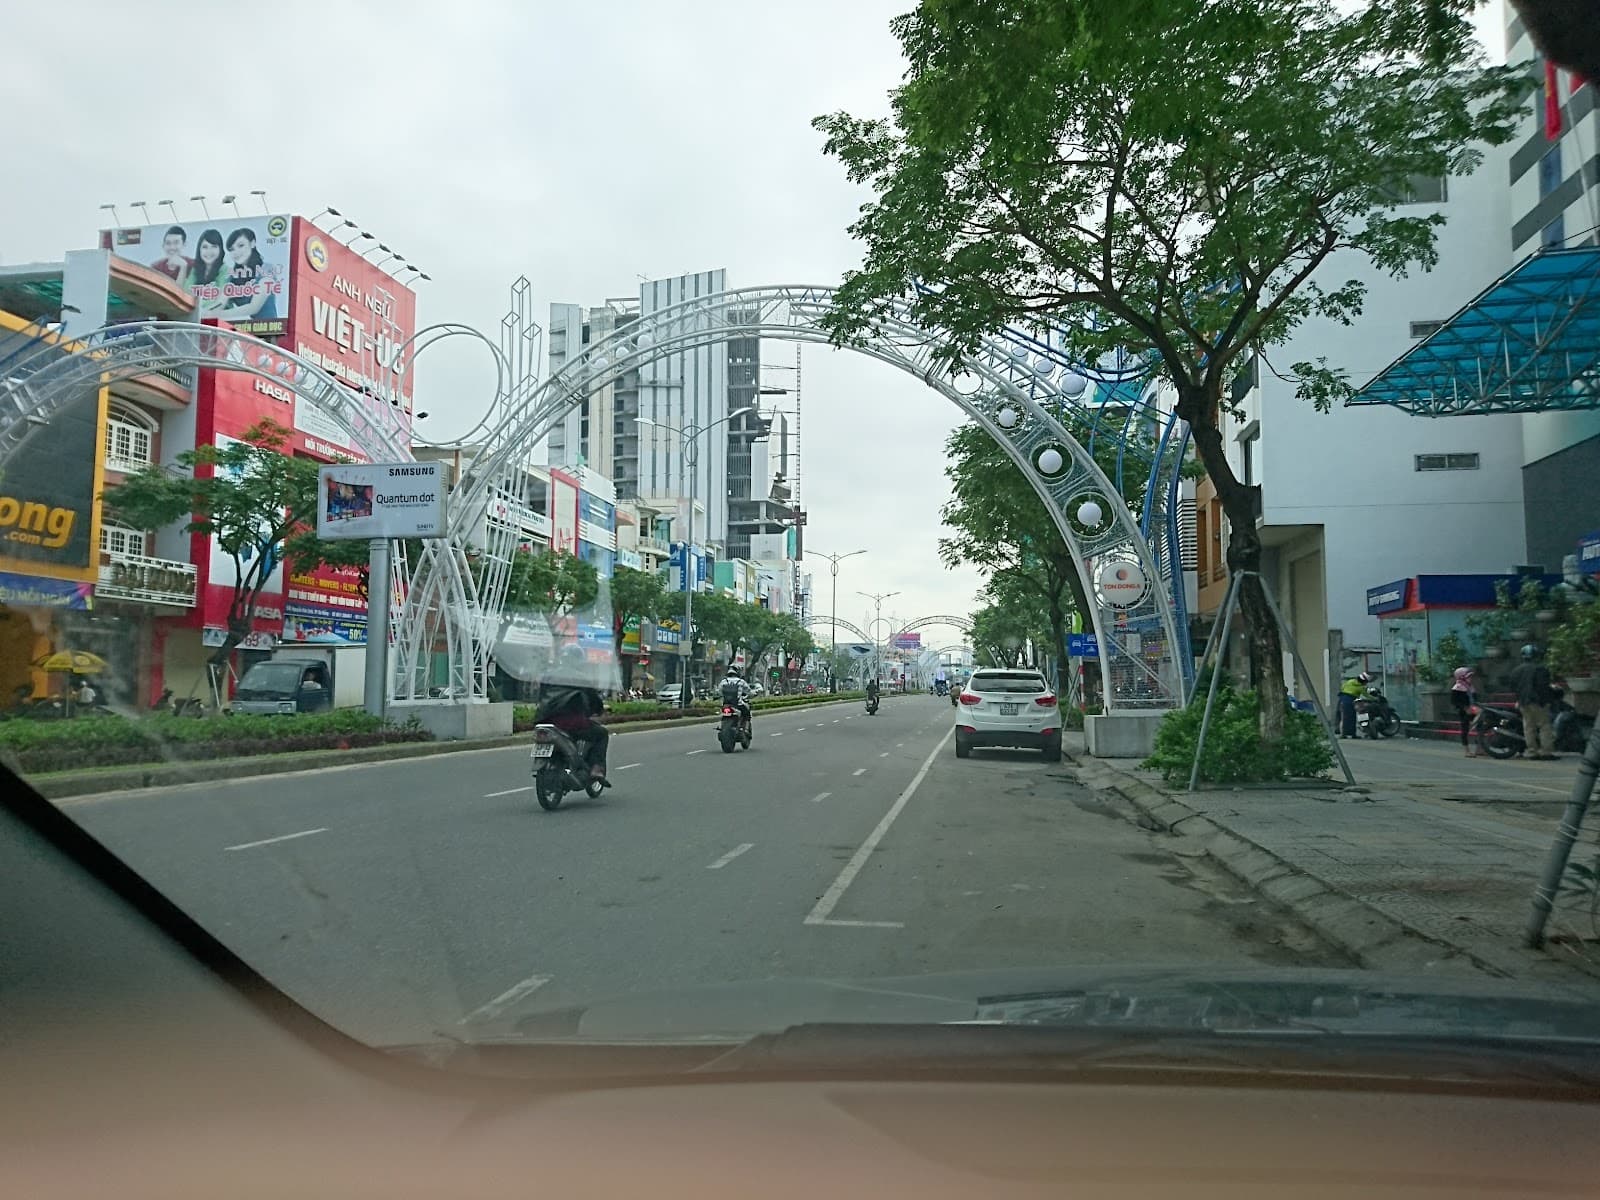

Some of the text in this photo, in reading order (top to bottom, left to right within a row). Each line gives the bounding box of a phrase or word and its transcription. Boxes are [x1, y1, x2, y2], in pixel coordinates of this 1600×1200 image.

[224, 278, 260, 297] Quốc
[264, 278, 284, 294] Tế
[333, 274, 361, 302] ANH
[255, 379, 291, 404] HASA
[389, 467, 435, 476] SAMSUNG
[376, 492, 435, 504] Quantum dot
[3, 531, 40, 545] .com
[349, 628, 363, 641] 50%
